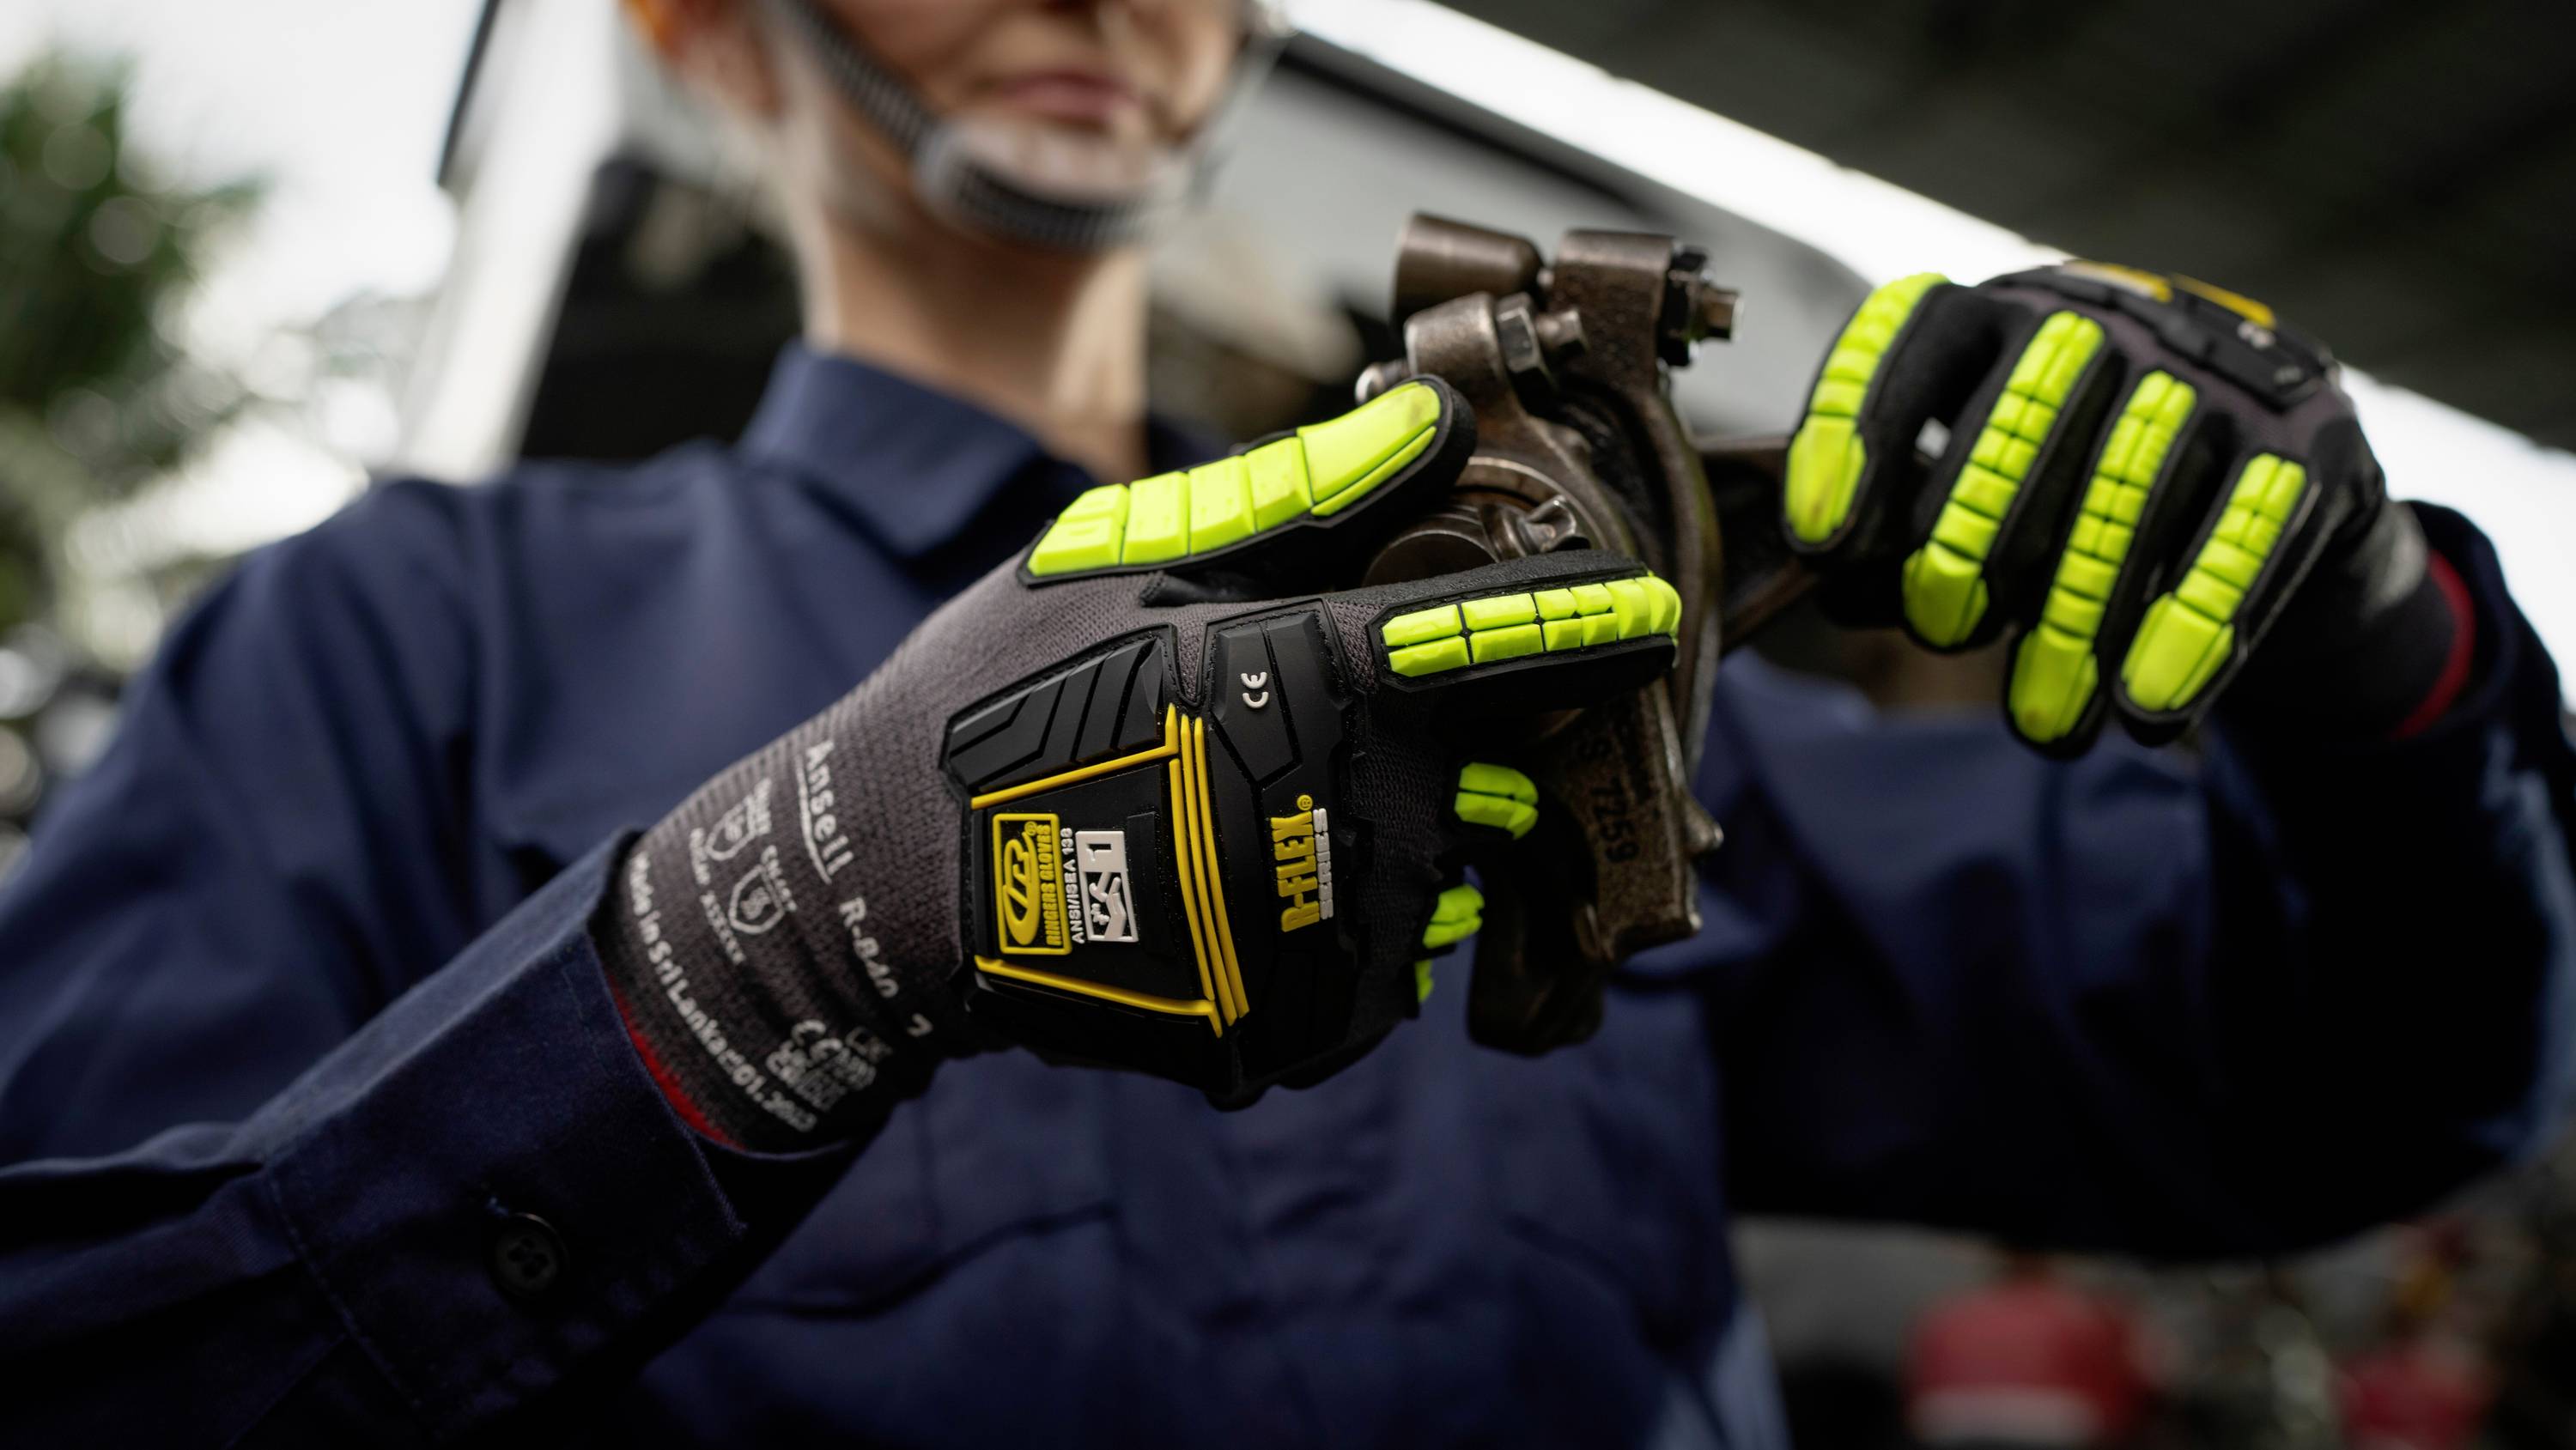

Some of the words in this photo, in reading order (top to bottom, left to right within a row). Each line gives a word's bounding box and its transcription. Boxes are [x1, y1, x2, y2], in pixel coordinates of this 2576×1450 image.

[1241, 671, 1269, 708] CE
[805, 739, 854, 877] Ansell
[1036, 823, 1054, 881] GLOVES
[1085, 841, 1113, 862] 1
[1312, 808, 1334, 920] SERIES
[638, 910, 662, 945] in
[1041, 883, 1062, 946] RINGERS
[1062, 859, 1085, 944] ANSI/ISEA
[647, 942, 688, 990] Sri
[668, 984, 732, 1056] Lanka
